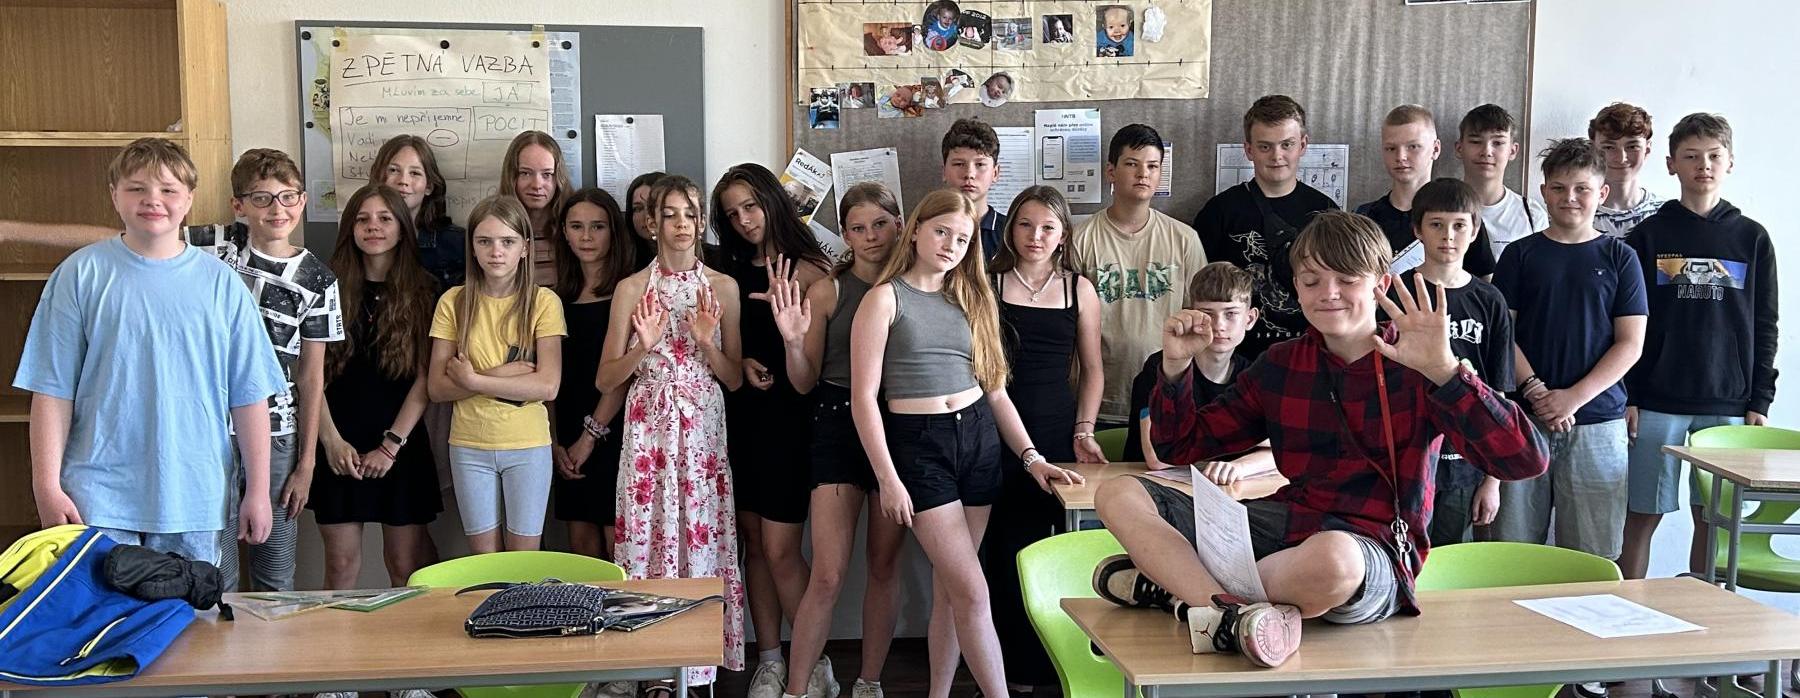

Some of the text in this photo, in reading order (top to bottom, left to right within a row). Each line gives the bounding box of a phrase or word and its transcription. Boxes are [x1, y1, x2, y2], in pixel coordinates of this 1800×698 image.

[461, 54, 535, 76] VAZBA
[455, 86, 480, 96] sebe
[344, 107, 368, 126] Je
[479, 114, 548, 132] POCIT
